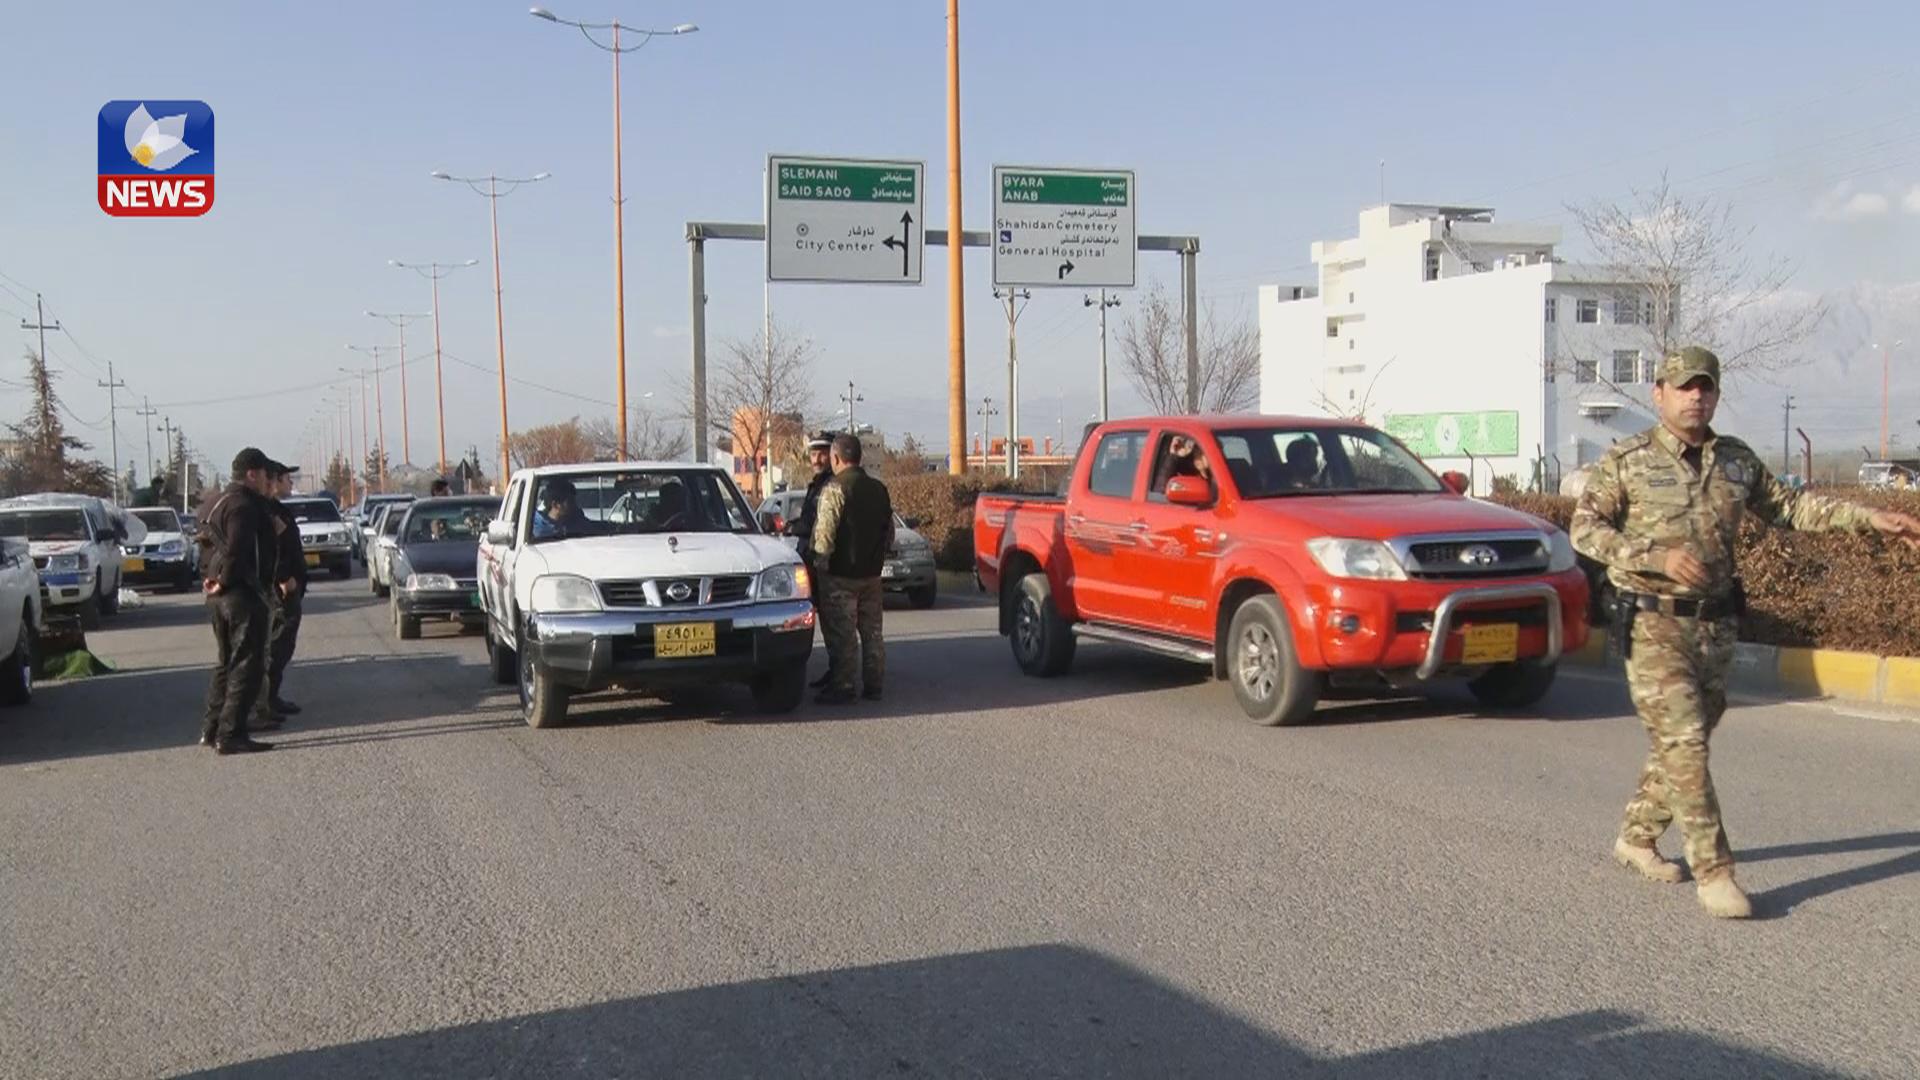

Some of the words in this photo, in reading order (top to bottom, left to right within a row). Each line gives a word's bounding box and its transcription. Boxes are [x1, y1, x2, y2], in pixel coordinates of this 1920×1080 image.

[781, 168, 838, 180] SLEMANI
[1003, 177, 1045, 188] BYARA
[781, 185, 812, 196] SAID
[1004, 190, 1039, 201] ANAB
[997, 219, 1054, 229] Shahidan
[1056, 219, 1118, 233] Cemetery
[795, 240, 824, 253] City
[828, 240, 875, 251] Center
[999, 246, 1048, 257] General
[1052, 246, 1106, 258] Hospital
